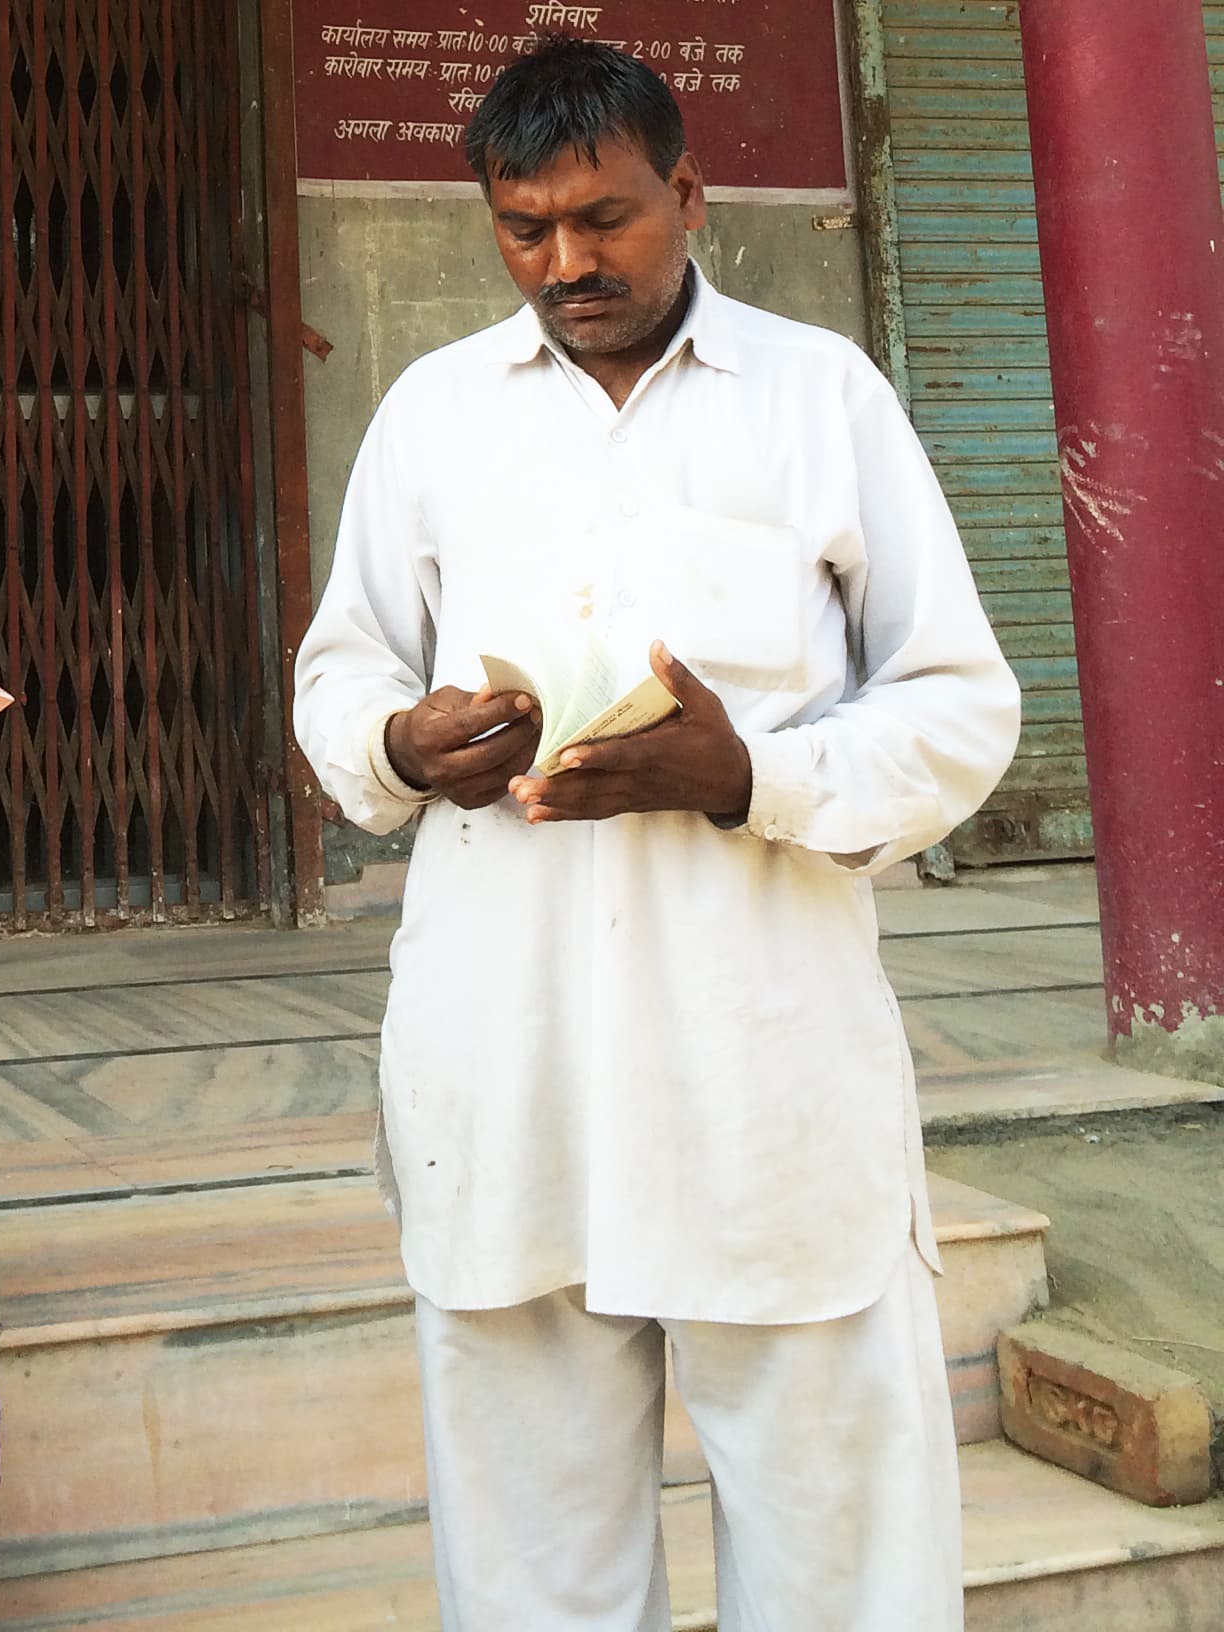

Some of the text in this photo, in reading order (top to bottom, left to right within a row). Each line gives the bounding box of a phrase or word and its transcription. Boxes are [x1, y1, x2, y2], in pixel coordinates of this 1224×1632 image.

[525, 0, 604, 33] शनिवार
[321, 19, 391, 49] कार्यालय
[678, 36, 707, 62] बजे
[714, 44, 745, 65] तक
[324, 51, 385, 80] कारोबार
[673, 68, 705, 92] बजे
[709, 73, 741, 93] तक
[333, 119, 465, 148] अगला अवकाश
